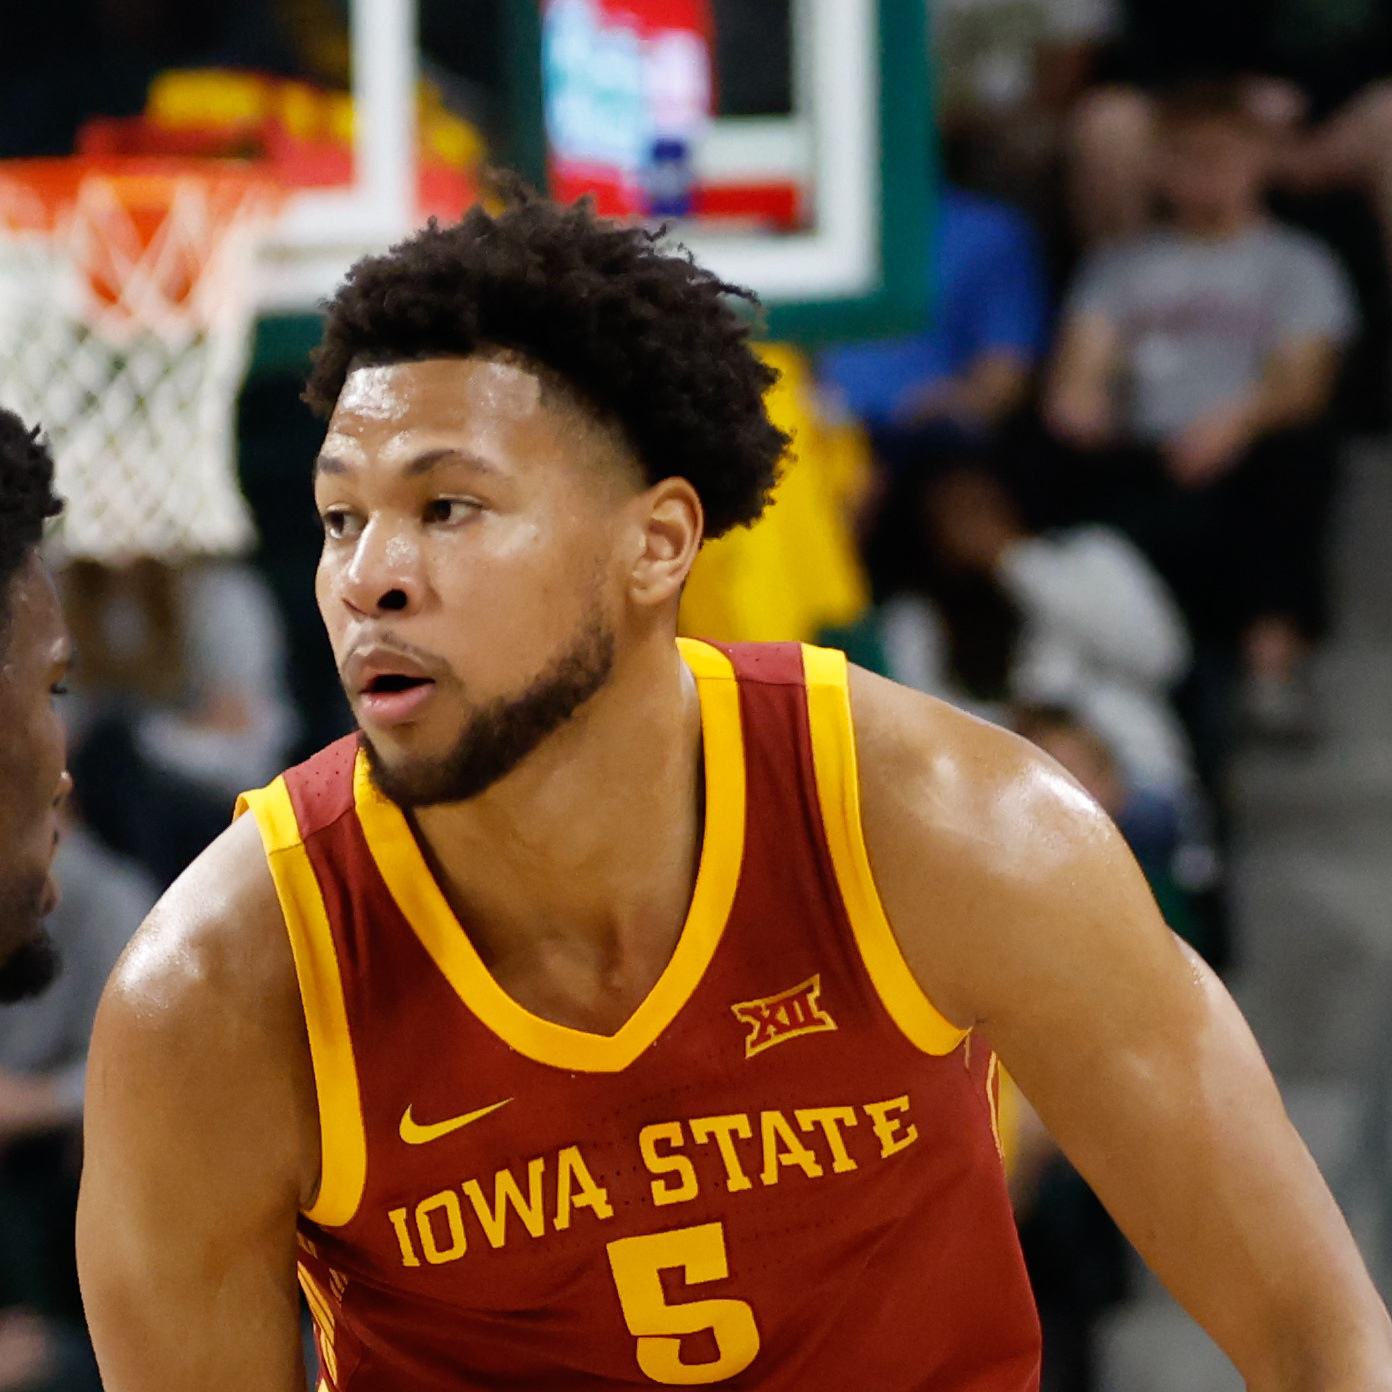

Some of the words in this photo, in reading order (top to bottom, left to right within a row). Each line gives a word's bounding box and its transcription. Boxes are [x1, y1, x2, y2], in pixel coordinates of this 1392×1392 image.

[388, 1145, 614, 1268] IOWA
[638, 1095, 919, 1206] STATE
[606, 1221, 761, 1386] 5
